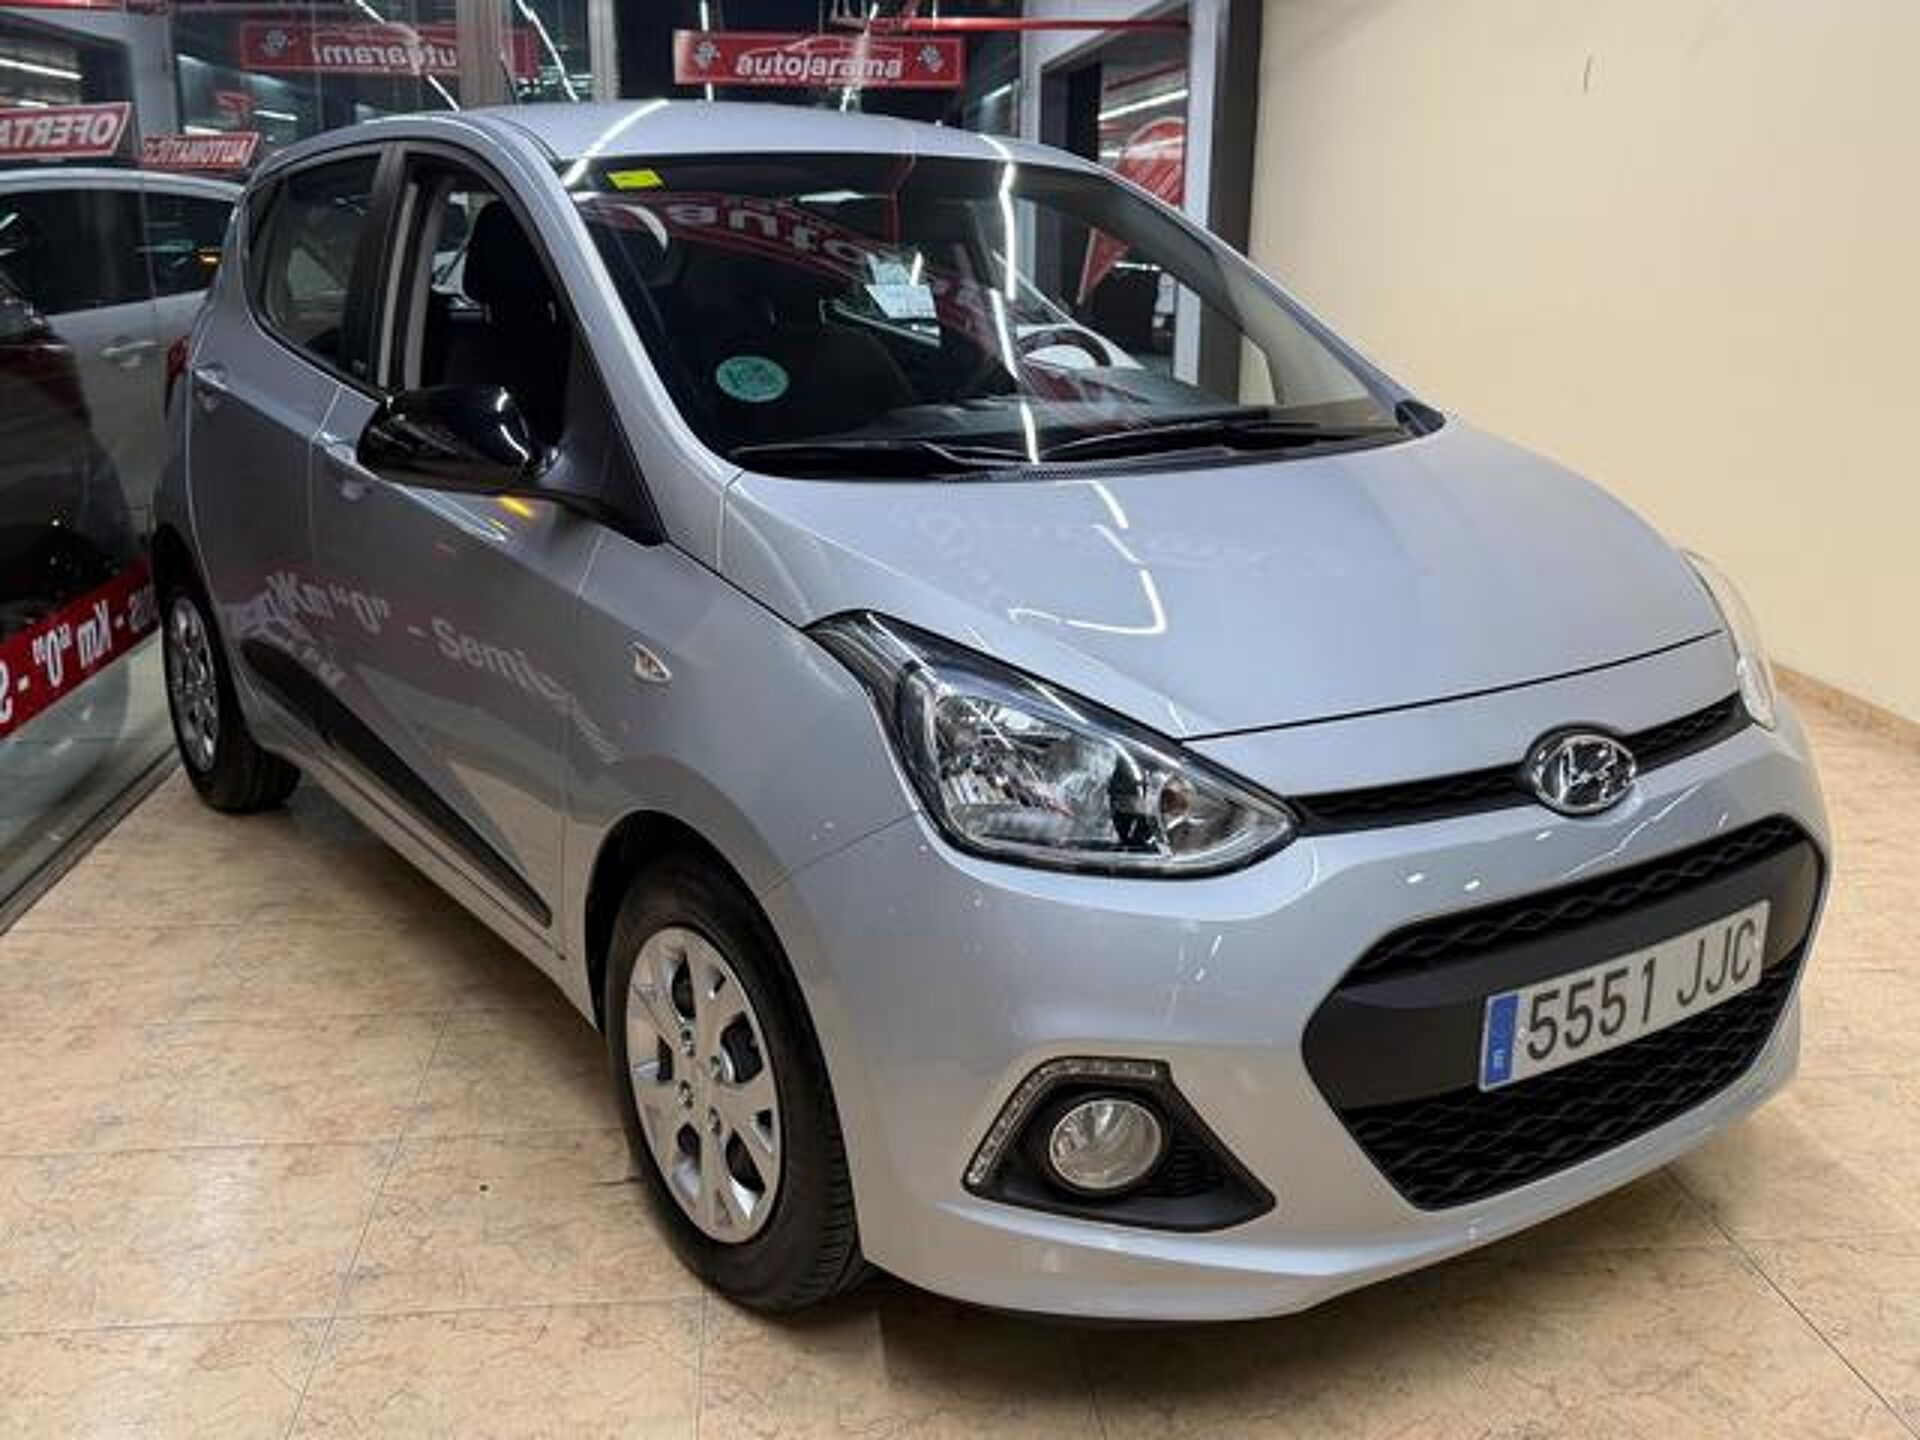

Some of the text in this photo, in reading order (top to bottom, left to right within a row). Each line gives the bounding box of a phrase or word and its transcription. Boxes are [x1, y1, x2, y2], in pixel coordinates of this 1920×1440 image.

[734, 50, 902, 81] autojarama
[1527, 918, 1756, 1060] 5551 JJC
